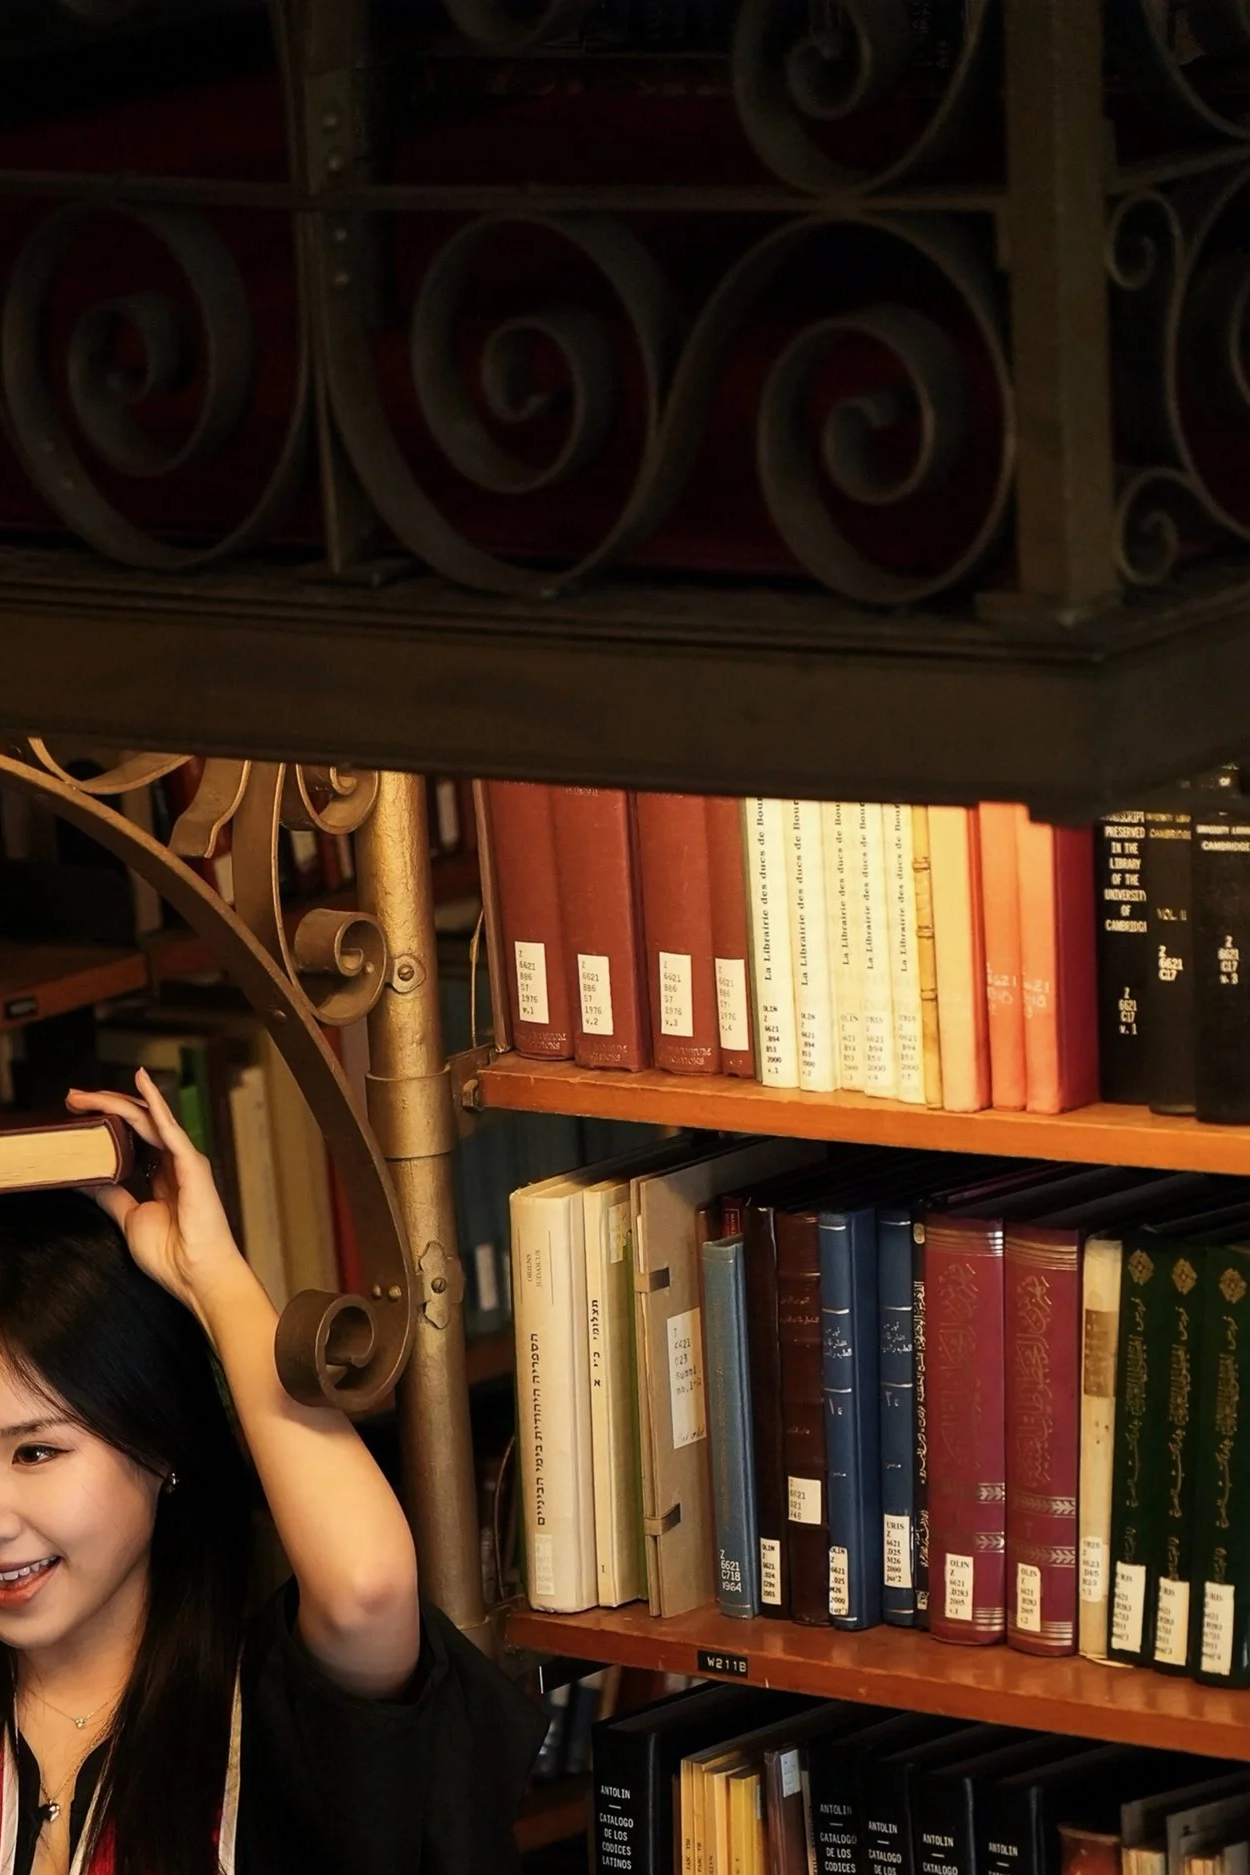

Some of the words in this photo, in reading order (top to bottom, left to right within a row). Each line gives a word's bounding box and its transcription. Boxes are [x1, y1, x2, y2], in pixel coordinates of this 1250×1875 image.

[758, 832, 764, 845] de
[836, 831, 843, 843] de
[1105, 827, 1145, 839] PRESERVED
[794, 837, 802, 850] de
[1112, 842, 1122, 854] IN
[1124, 843, 1139, 854] THE
[759, 851, 767, 879] ducs
[1110, 858, 1141, 870] LIBRARY
[1112, 873, 1122, 885] OF
[1125, 873, 1139, 886] THE
[1121, 905, 1131, 917] OF
[840, 901, 849, 948] Librairie
[763, 909, 771, 962] Librairie
[799, 914, 807, 966] Librairie
[1218, 948, 1239, 961] 6621
[519, 961, 536, 970] 6621
[1159, 958, 1183, 970] 6621
[1221, 961, 1237, 972] C17
[583, 972, 599, 982] 6621
[664, 973, 682, 982] 6621
[1159, 970, 1177, 981] C17
[522, 995, 538, 1003] 1976
[585, 1005, 602, 1015] 1976
[665, 1005, 683, 1016] 1976
[1119, 1000, 1137, 1012] 6621
[1121, 1012, 1135, 1022] C17
[886, 1521, 904, 1530] URIS
[886, 1539, 901, 1547] 6621
[721, 1560, 740, 1571] 6621
[887, 1557, 901, 1565] M26
[950, 1560, 970, 1569] OLIN
[721, 1571, 741, 1582] C718
[722, 1582, 742, 1592] 1964
[707, 1656, 747, 1672] W211B
[601, 1785, 630, 1799] ANTOLIN
[600, 1812, 634, 1828] CATALOGO
[869, 1821, 898, 1834] ANTOLIN
[604, 1828, 613, 1839] DE
[614, 1829, 628, 1841] LOS
[820, 1832, 857, 1845] CATALOGO
[923, 1833, 954, 1847] ANTOLIN
[602, 1842, 631, 1856] CODICES
[826, 1849, 835, 1858] DE
[837, 1849, 851, 1859] LOS
[989, 1842, 1018, 1856] ANTOLIN
[602, 1855, 632, 1870] LATINOS
[869, 1849, 902, 1864] CATALOGO
[825, 1861, 856, 1873] CODICES
[874, 1864, 882, 1875] DE
